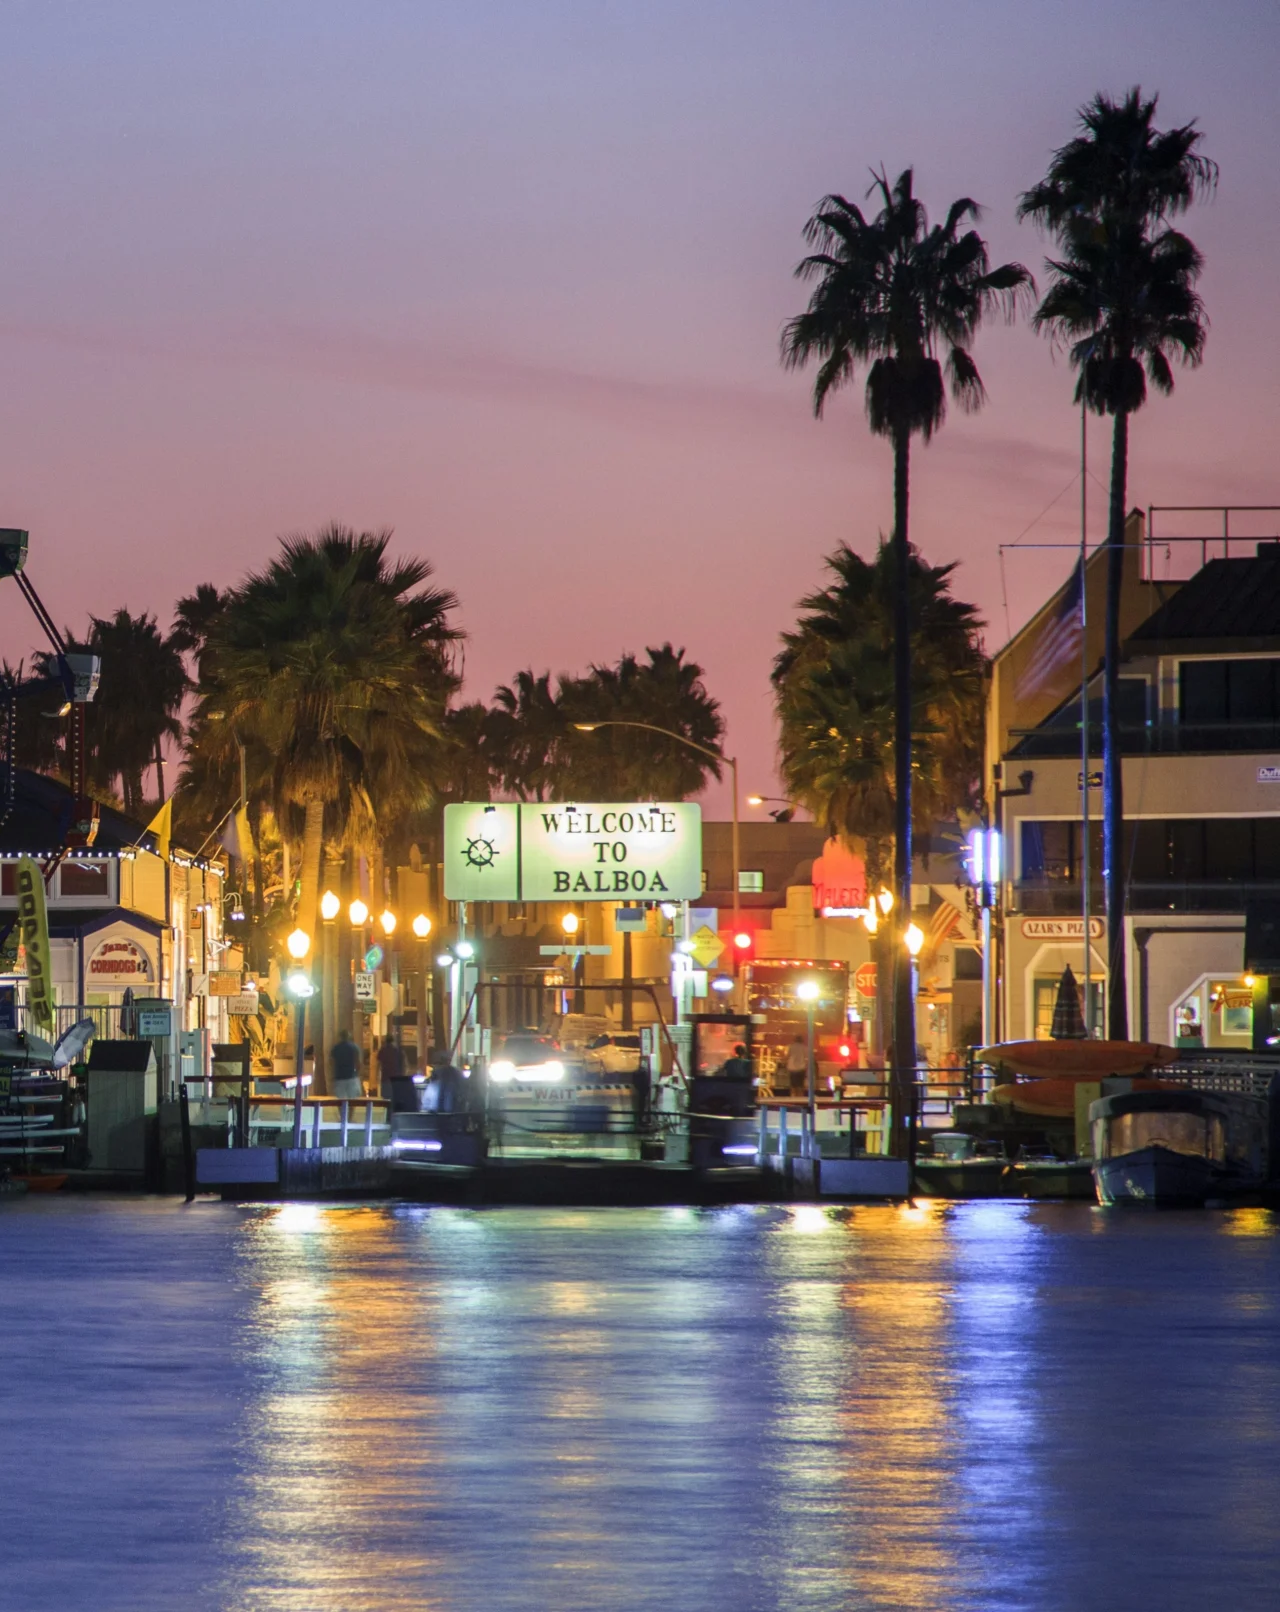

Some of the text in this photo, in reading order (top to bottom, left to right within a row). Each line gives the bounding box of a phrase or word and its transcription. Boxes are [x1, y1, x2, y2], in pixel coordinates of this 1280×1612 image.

[541, 811, 677, 834] WELCOME
[593, 841, 627, 863] TO
[553, 870, 669, 893] BALBOA
[1027, 923, 1097, 933] AZAR'S PIZA
[100, 943, 137, 956] Jane's
[91, 959, 136, 973] CORNDOGS
[856, 973, 877, 988] STO
[534, 1088, 576, 1100] WAIT
